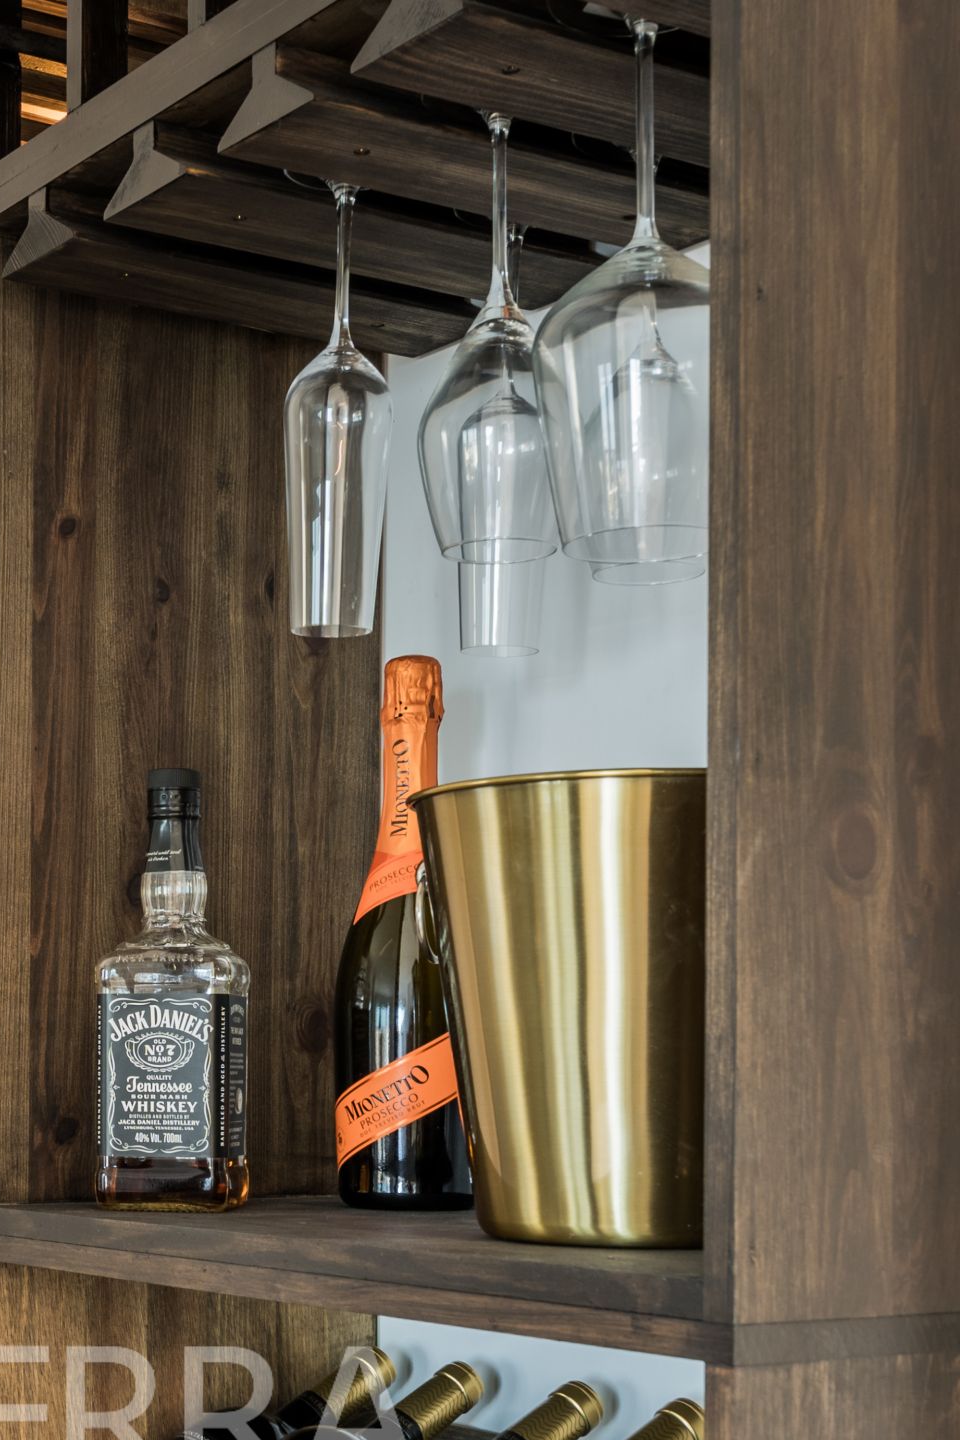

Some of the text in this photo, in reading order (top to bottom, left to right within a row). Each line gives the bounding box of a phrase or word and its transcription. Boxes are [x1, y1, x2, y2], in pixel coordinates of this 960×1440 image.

[108, 1010, 149, 1042] JACK
[149, 1004, 214, 1043] DANIEL'S
[126, 1076, 193, 1093] Tennessee
[121, 1100, 198, 1113] WHISKEY
[360, 1093, 418, 1130] PROSECCO
[134, 1132, 150, 1143] 40%
